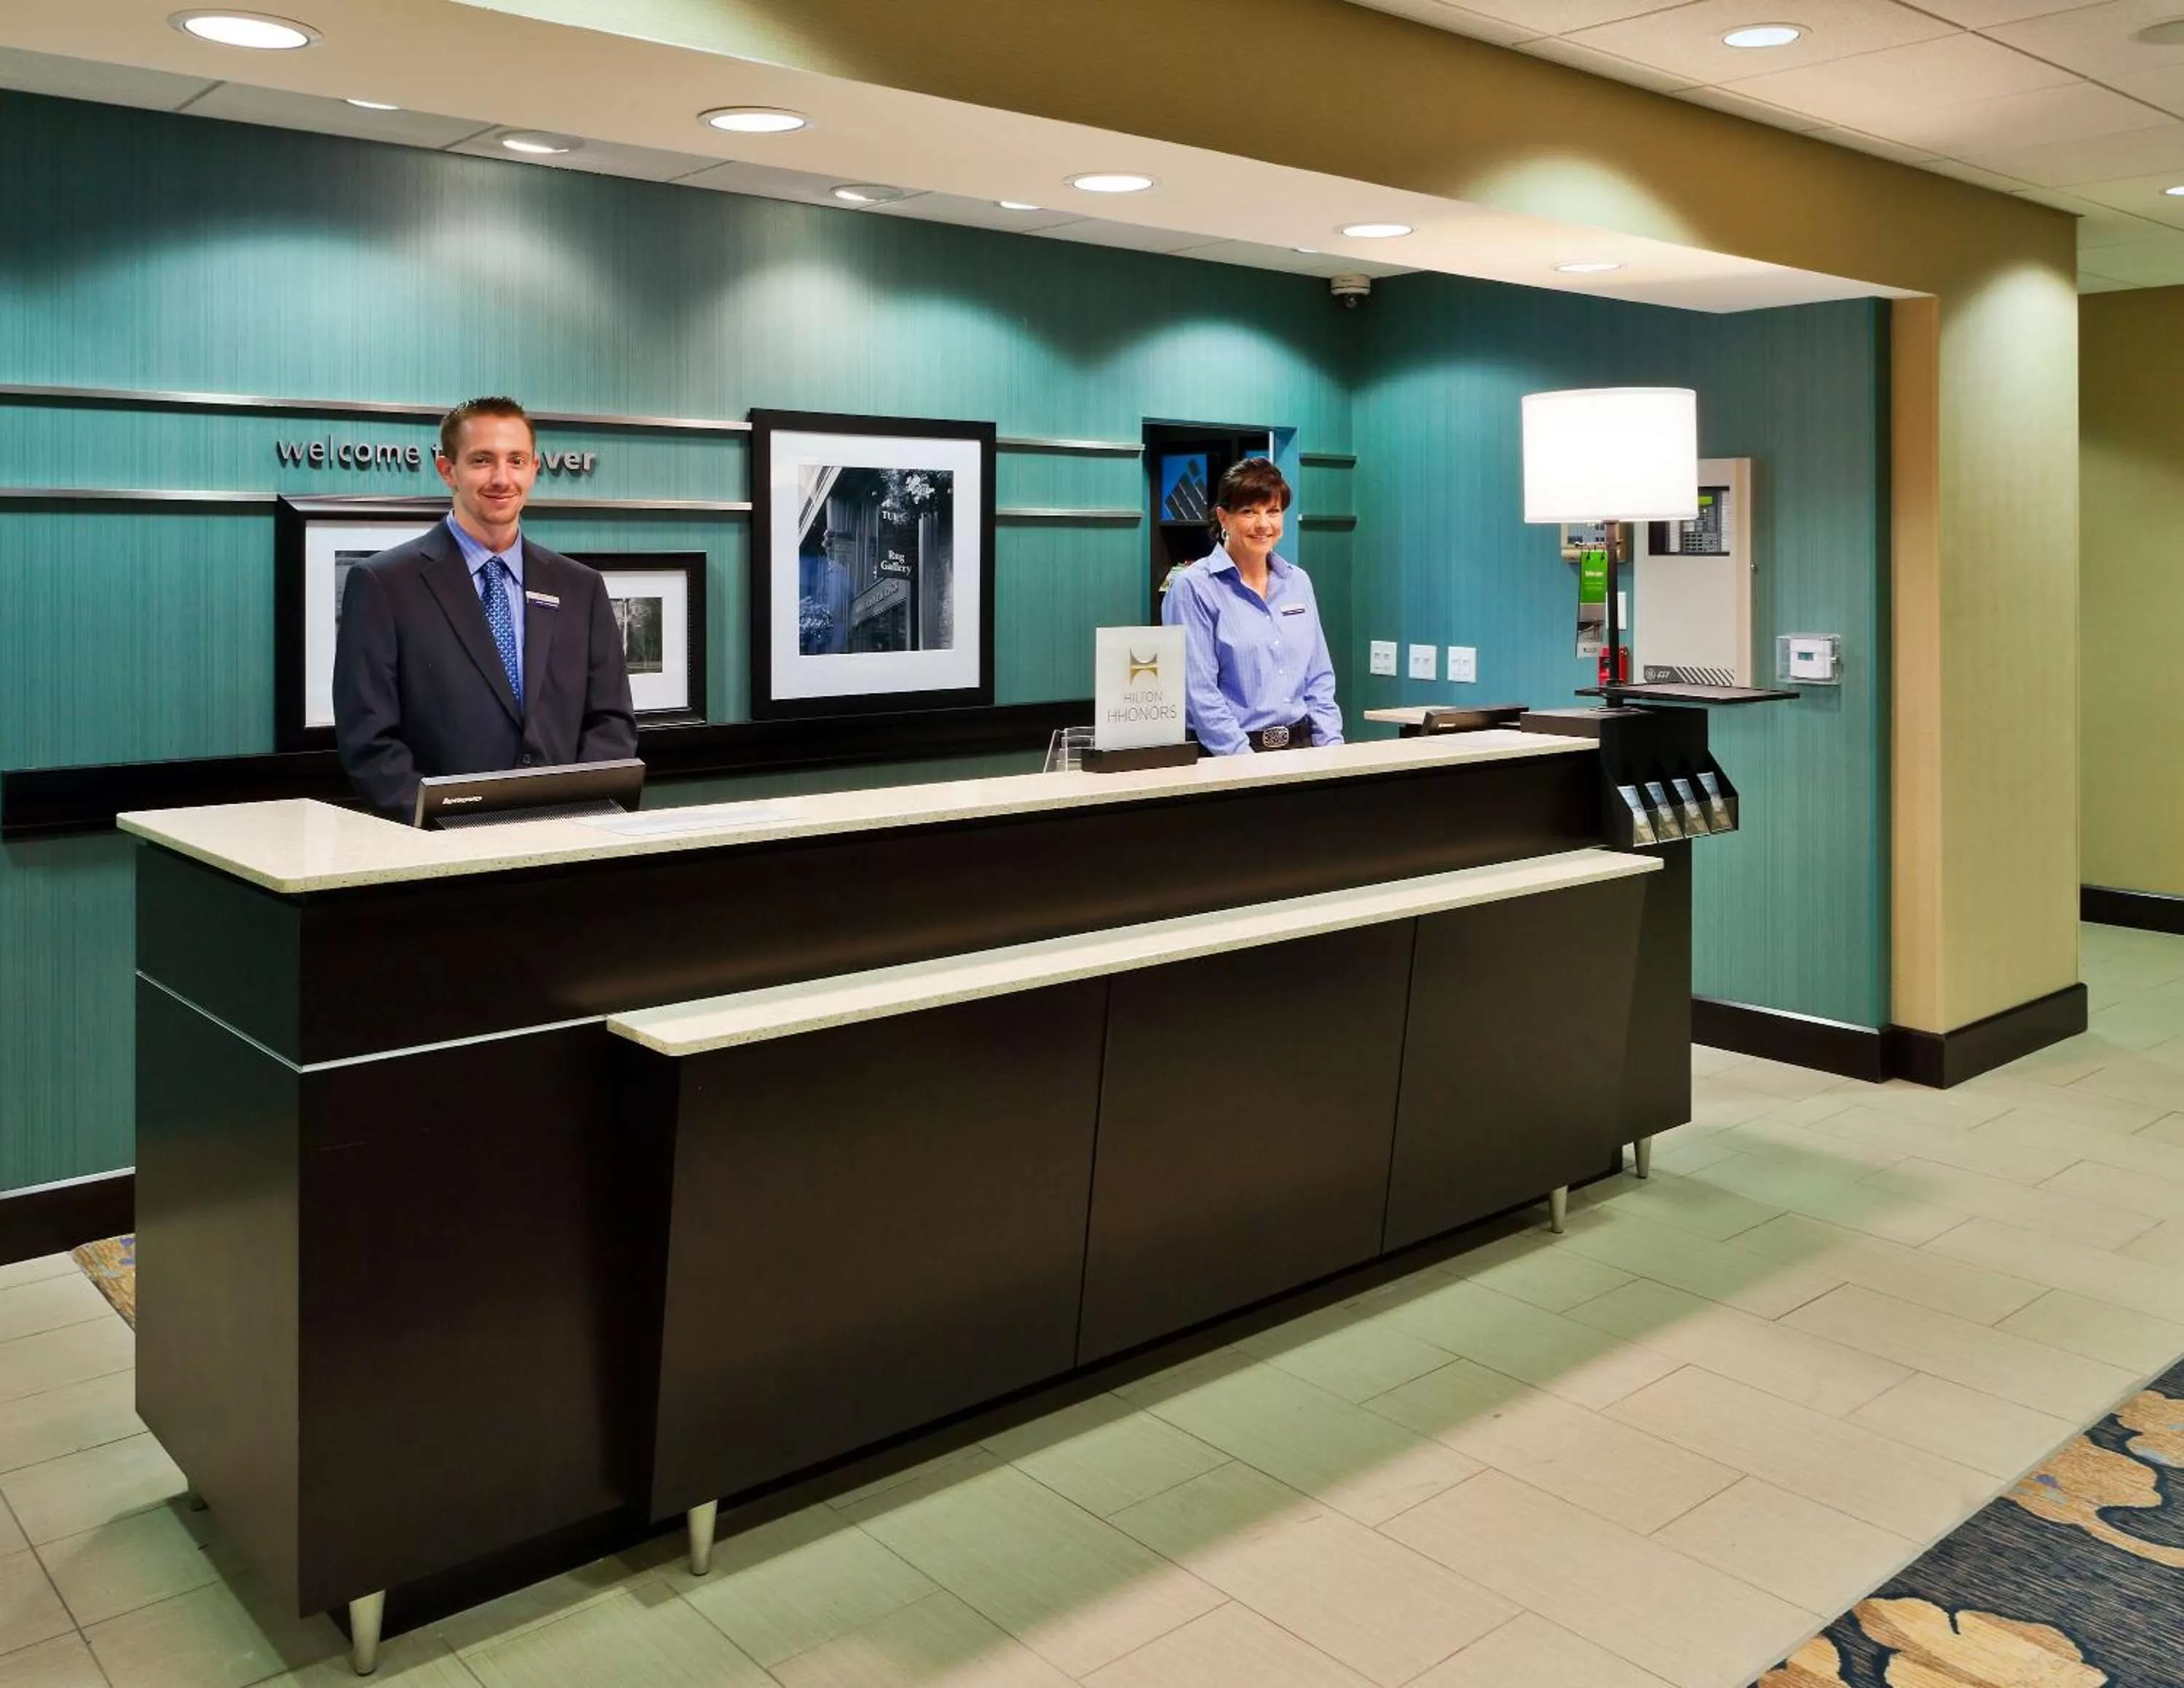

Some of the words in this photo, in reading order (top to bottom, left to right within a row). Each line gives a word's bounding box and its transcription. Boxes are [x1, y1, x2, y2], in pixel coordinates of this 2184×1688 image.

[277, 433, 420, 465] welcome
[542, 450, 596, 472] ver
[880, 560, 911, 576] Gallery
[1123, 690, 1163, 704] HILTON
[1107, 704, 1177, 723] HHONORS
